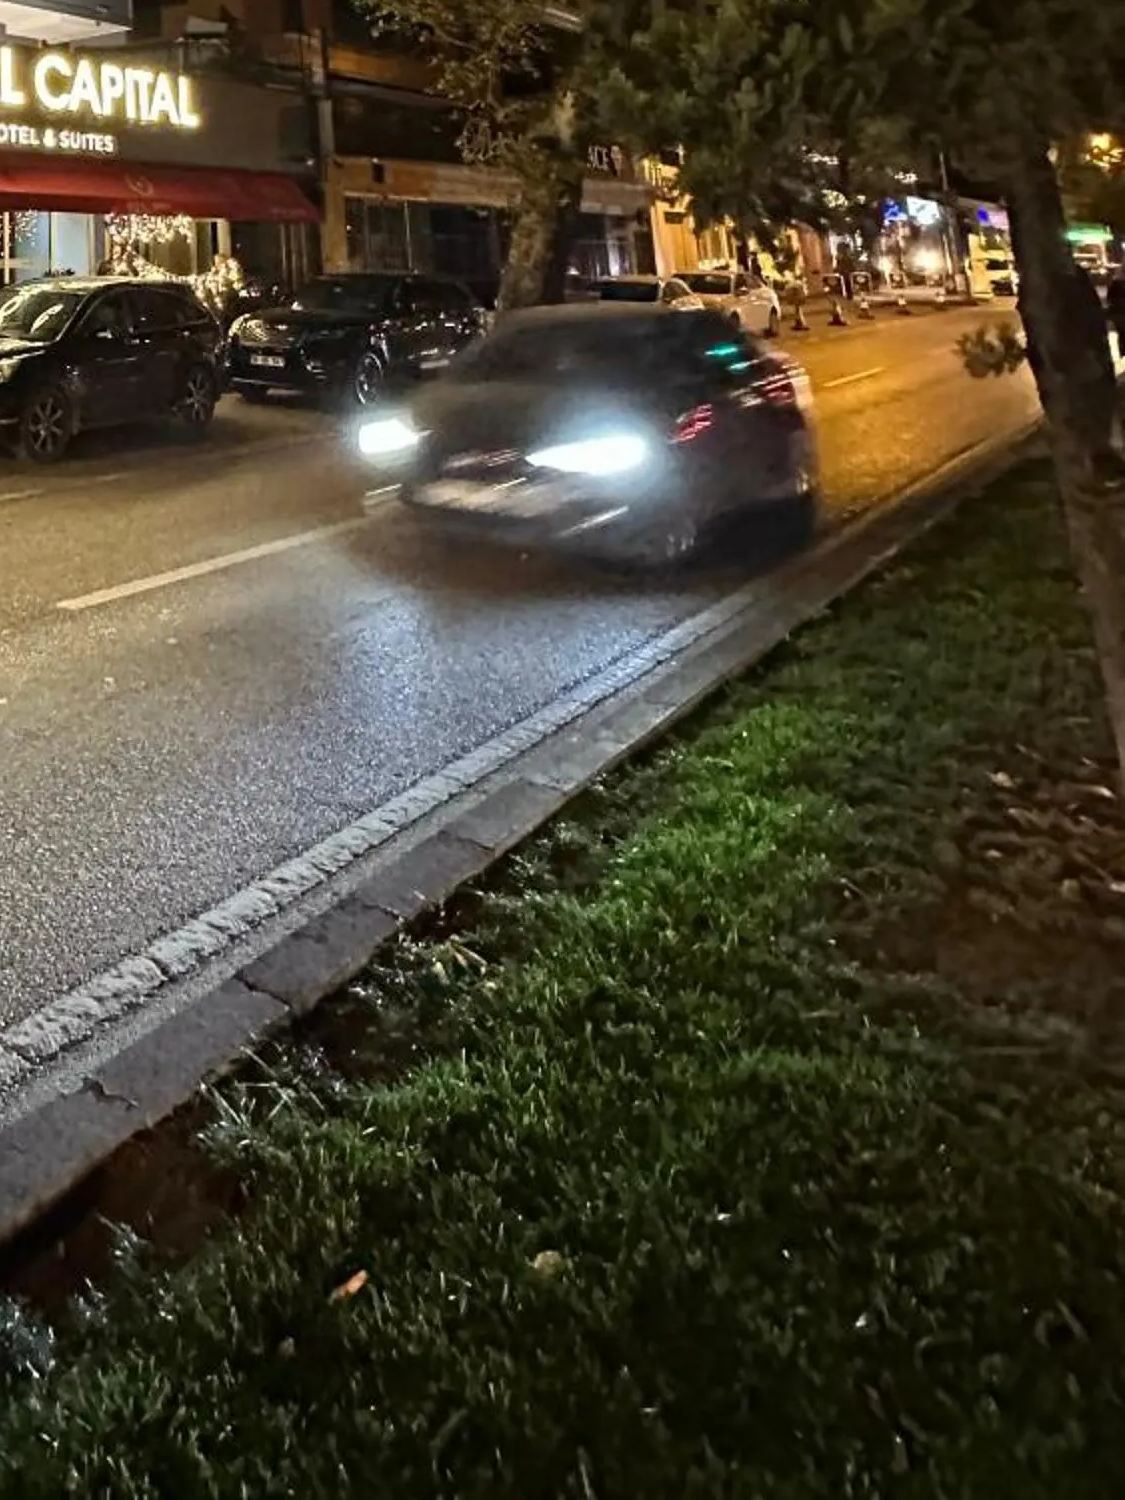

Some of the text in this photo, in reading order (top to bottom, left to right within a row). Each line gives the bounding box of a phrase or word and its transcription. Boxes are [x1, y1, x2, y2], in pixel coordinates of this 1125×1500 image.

[32, 52, 201, 129] CAPITAL
[42, 129, 58, 148] &
[59, 131, 116, 154] SUITES
